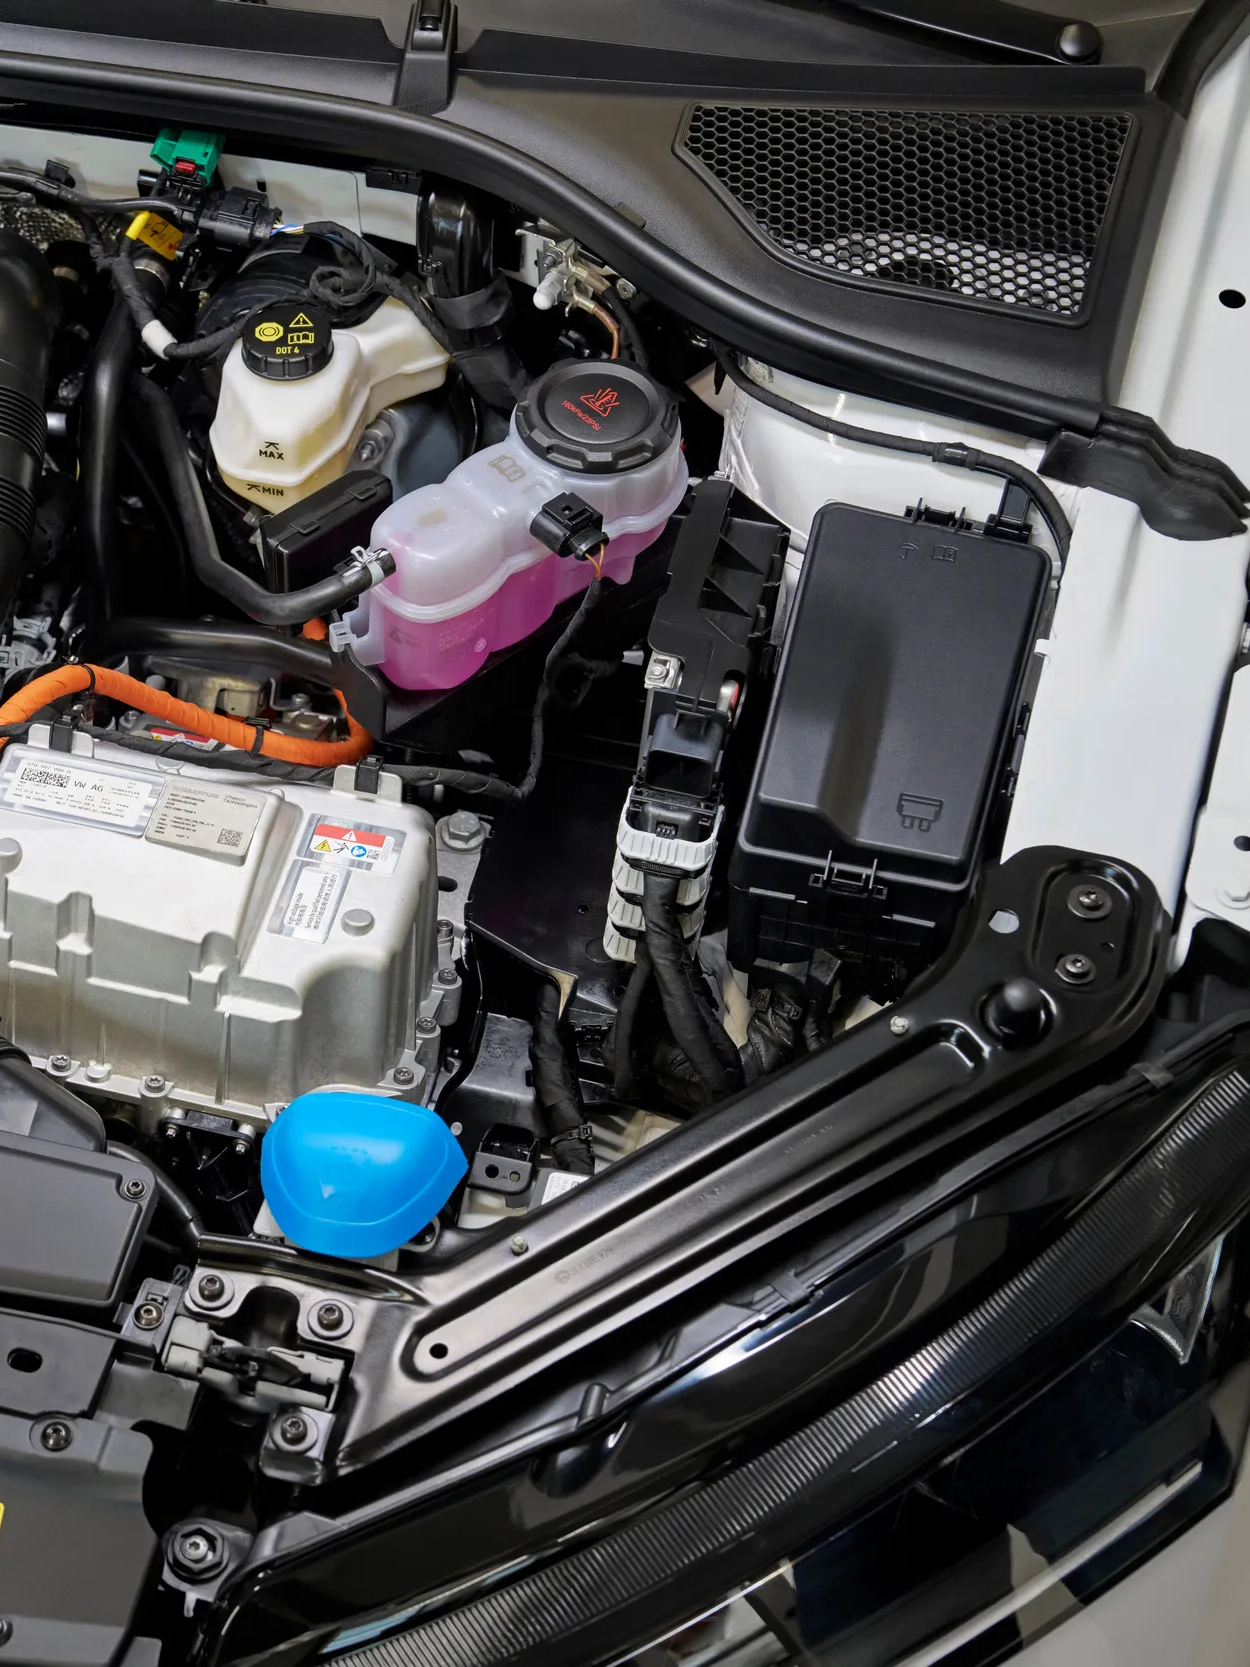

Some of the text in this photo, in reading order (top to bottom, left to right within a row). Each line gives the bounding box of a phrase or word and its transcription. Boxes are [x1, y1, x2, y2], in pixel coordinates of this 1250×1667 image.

[276, 346, 300, 354] DOT 4
[259, 450, 284, 460] MAX
[262, 487, 284, 496] MIN
[74, 780, 87, 788] VW
